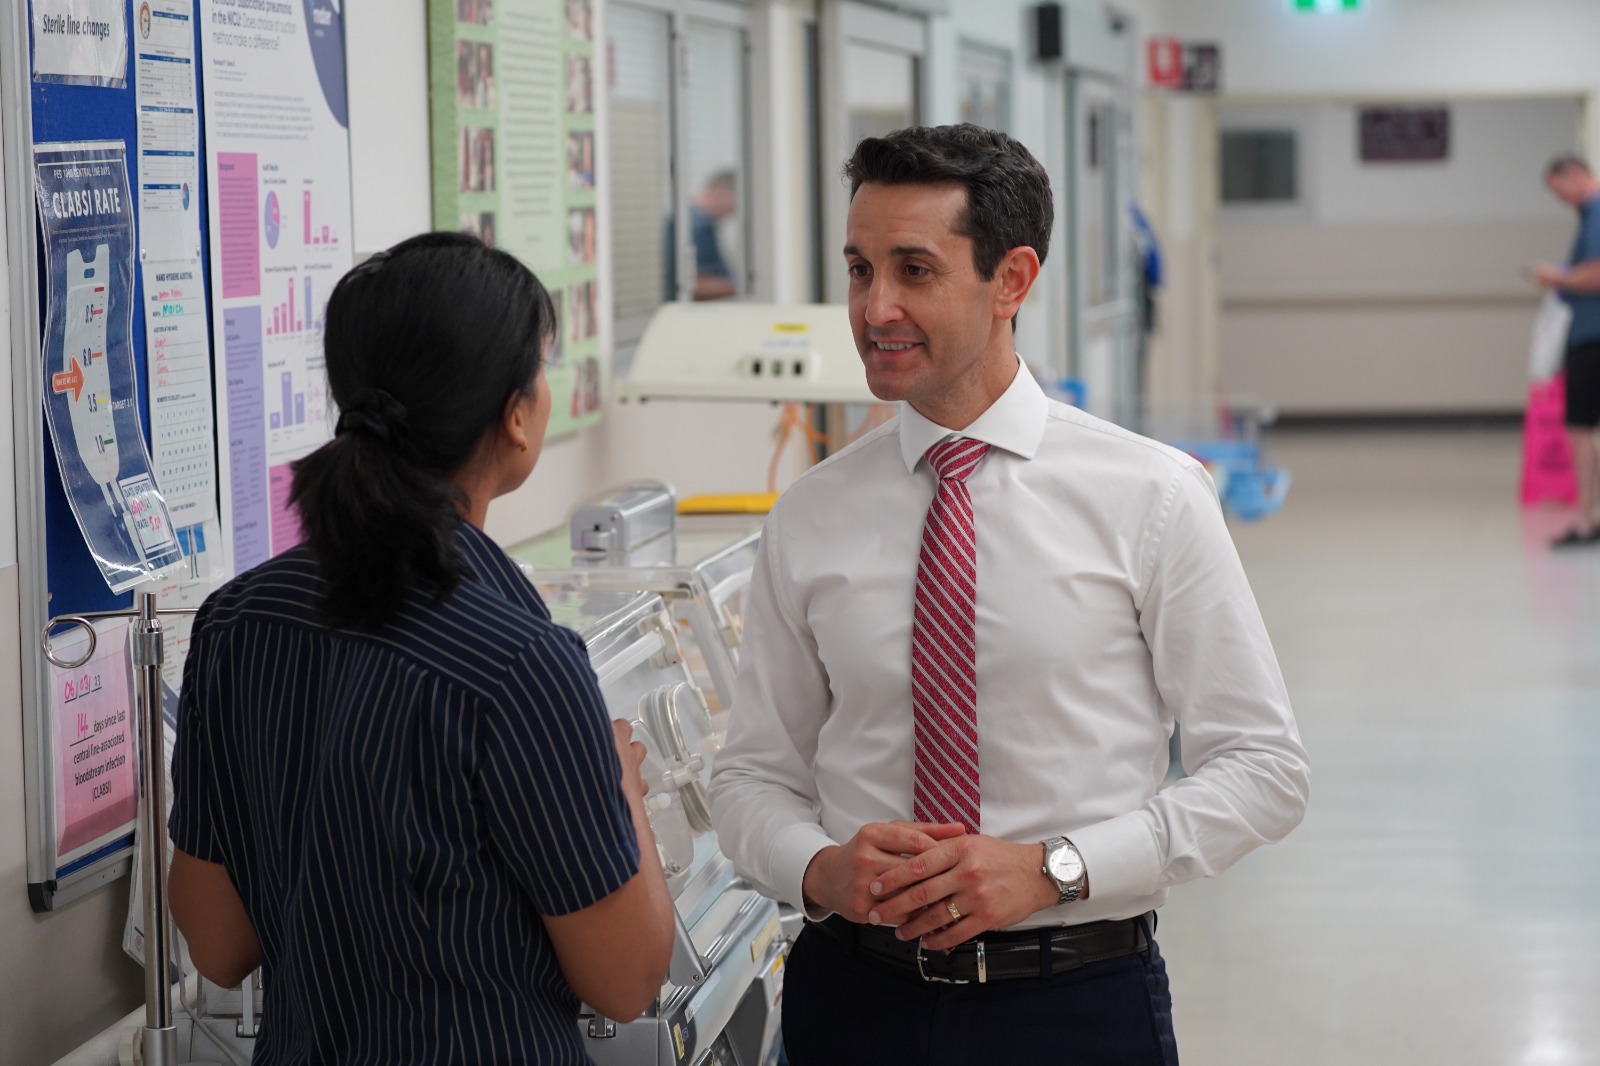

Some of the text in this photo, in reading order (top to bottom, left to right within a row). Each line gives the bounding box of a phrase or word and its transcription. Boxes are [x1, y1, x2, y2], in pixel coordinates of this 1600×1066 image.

[43, 14, 110, 41] Sterile line changes
[52, 190, 93, 219] CLABSI
[94, 188, 121, 215] RATE
[163, 303, 183, 314] March
[88, 393, 97, 413] 3.5
[77, 710, 125, 739] 14 days since last
[73, 731, 124, 764] central line-associated
[75, 754, 125, 786] bloodstream infection
[92, 779, 112, 802] (CLABSI)
